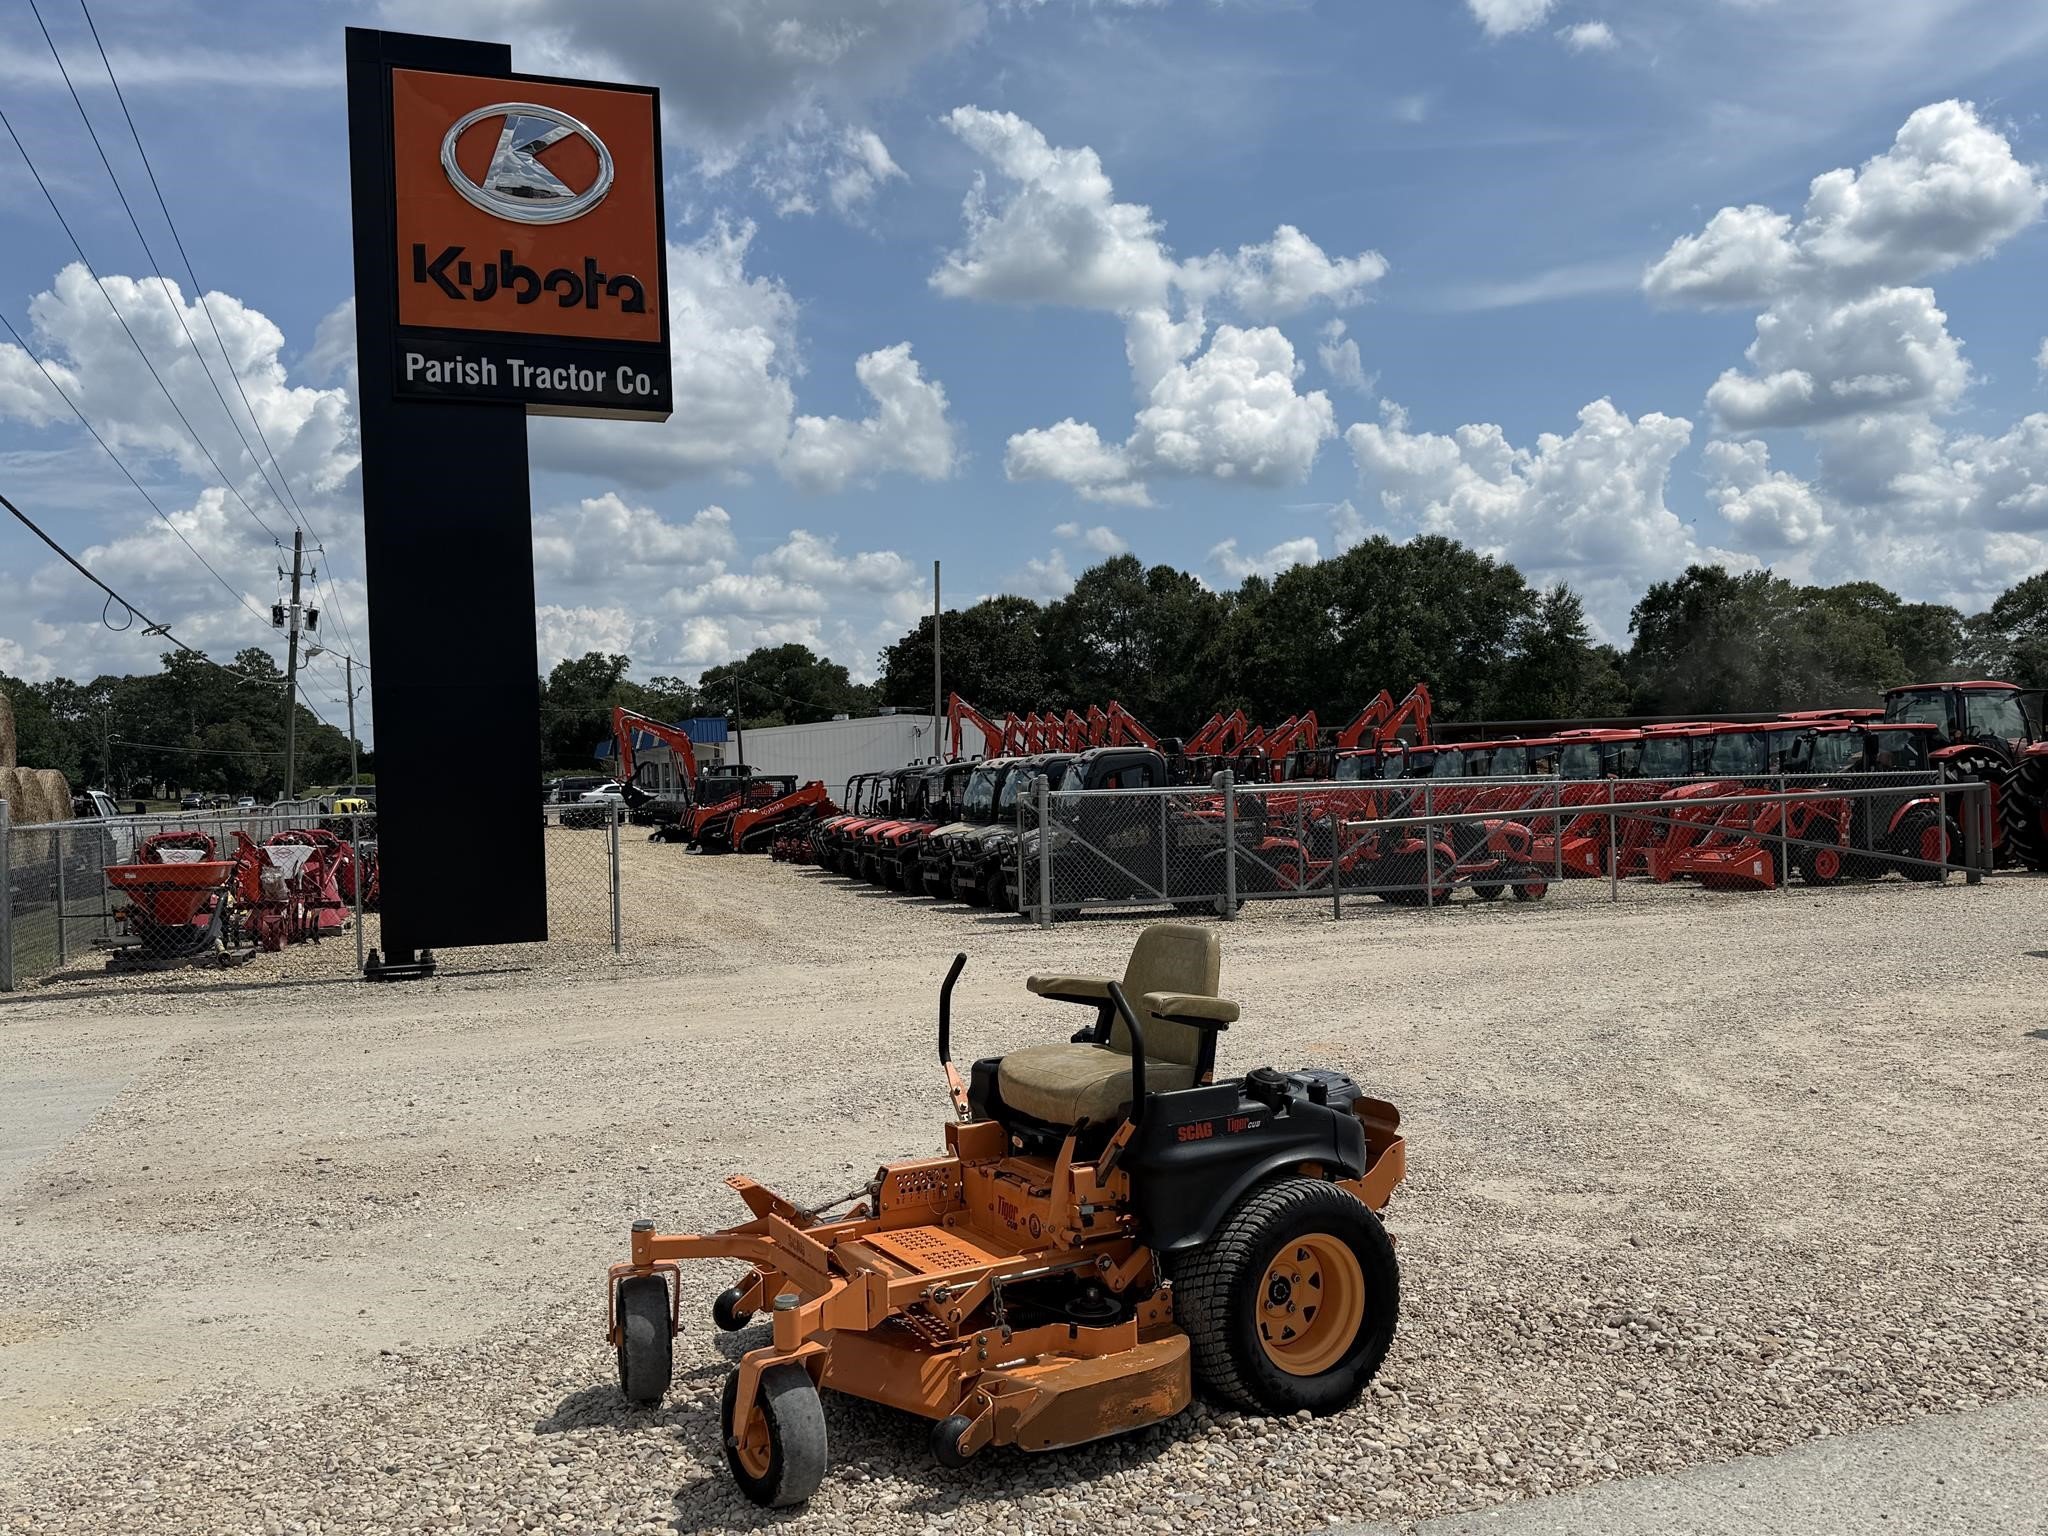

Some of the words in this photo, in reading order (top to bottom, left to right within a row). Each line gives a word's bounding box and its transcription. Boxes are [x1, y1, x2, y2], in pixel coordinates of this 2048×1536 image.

[412, 243, 646, 314] Kubota
[405, 352, 497, 386] Parish
[506, 358, 607, 392] Tractor
[616, 366, 659, 395] Co.
[1178, 1121, 1213, 1142] SCAG
[1226, 1117, 1249, 1133] Tiger
[997, 1194, 1019, 1221] Tiger
